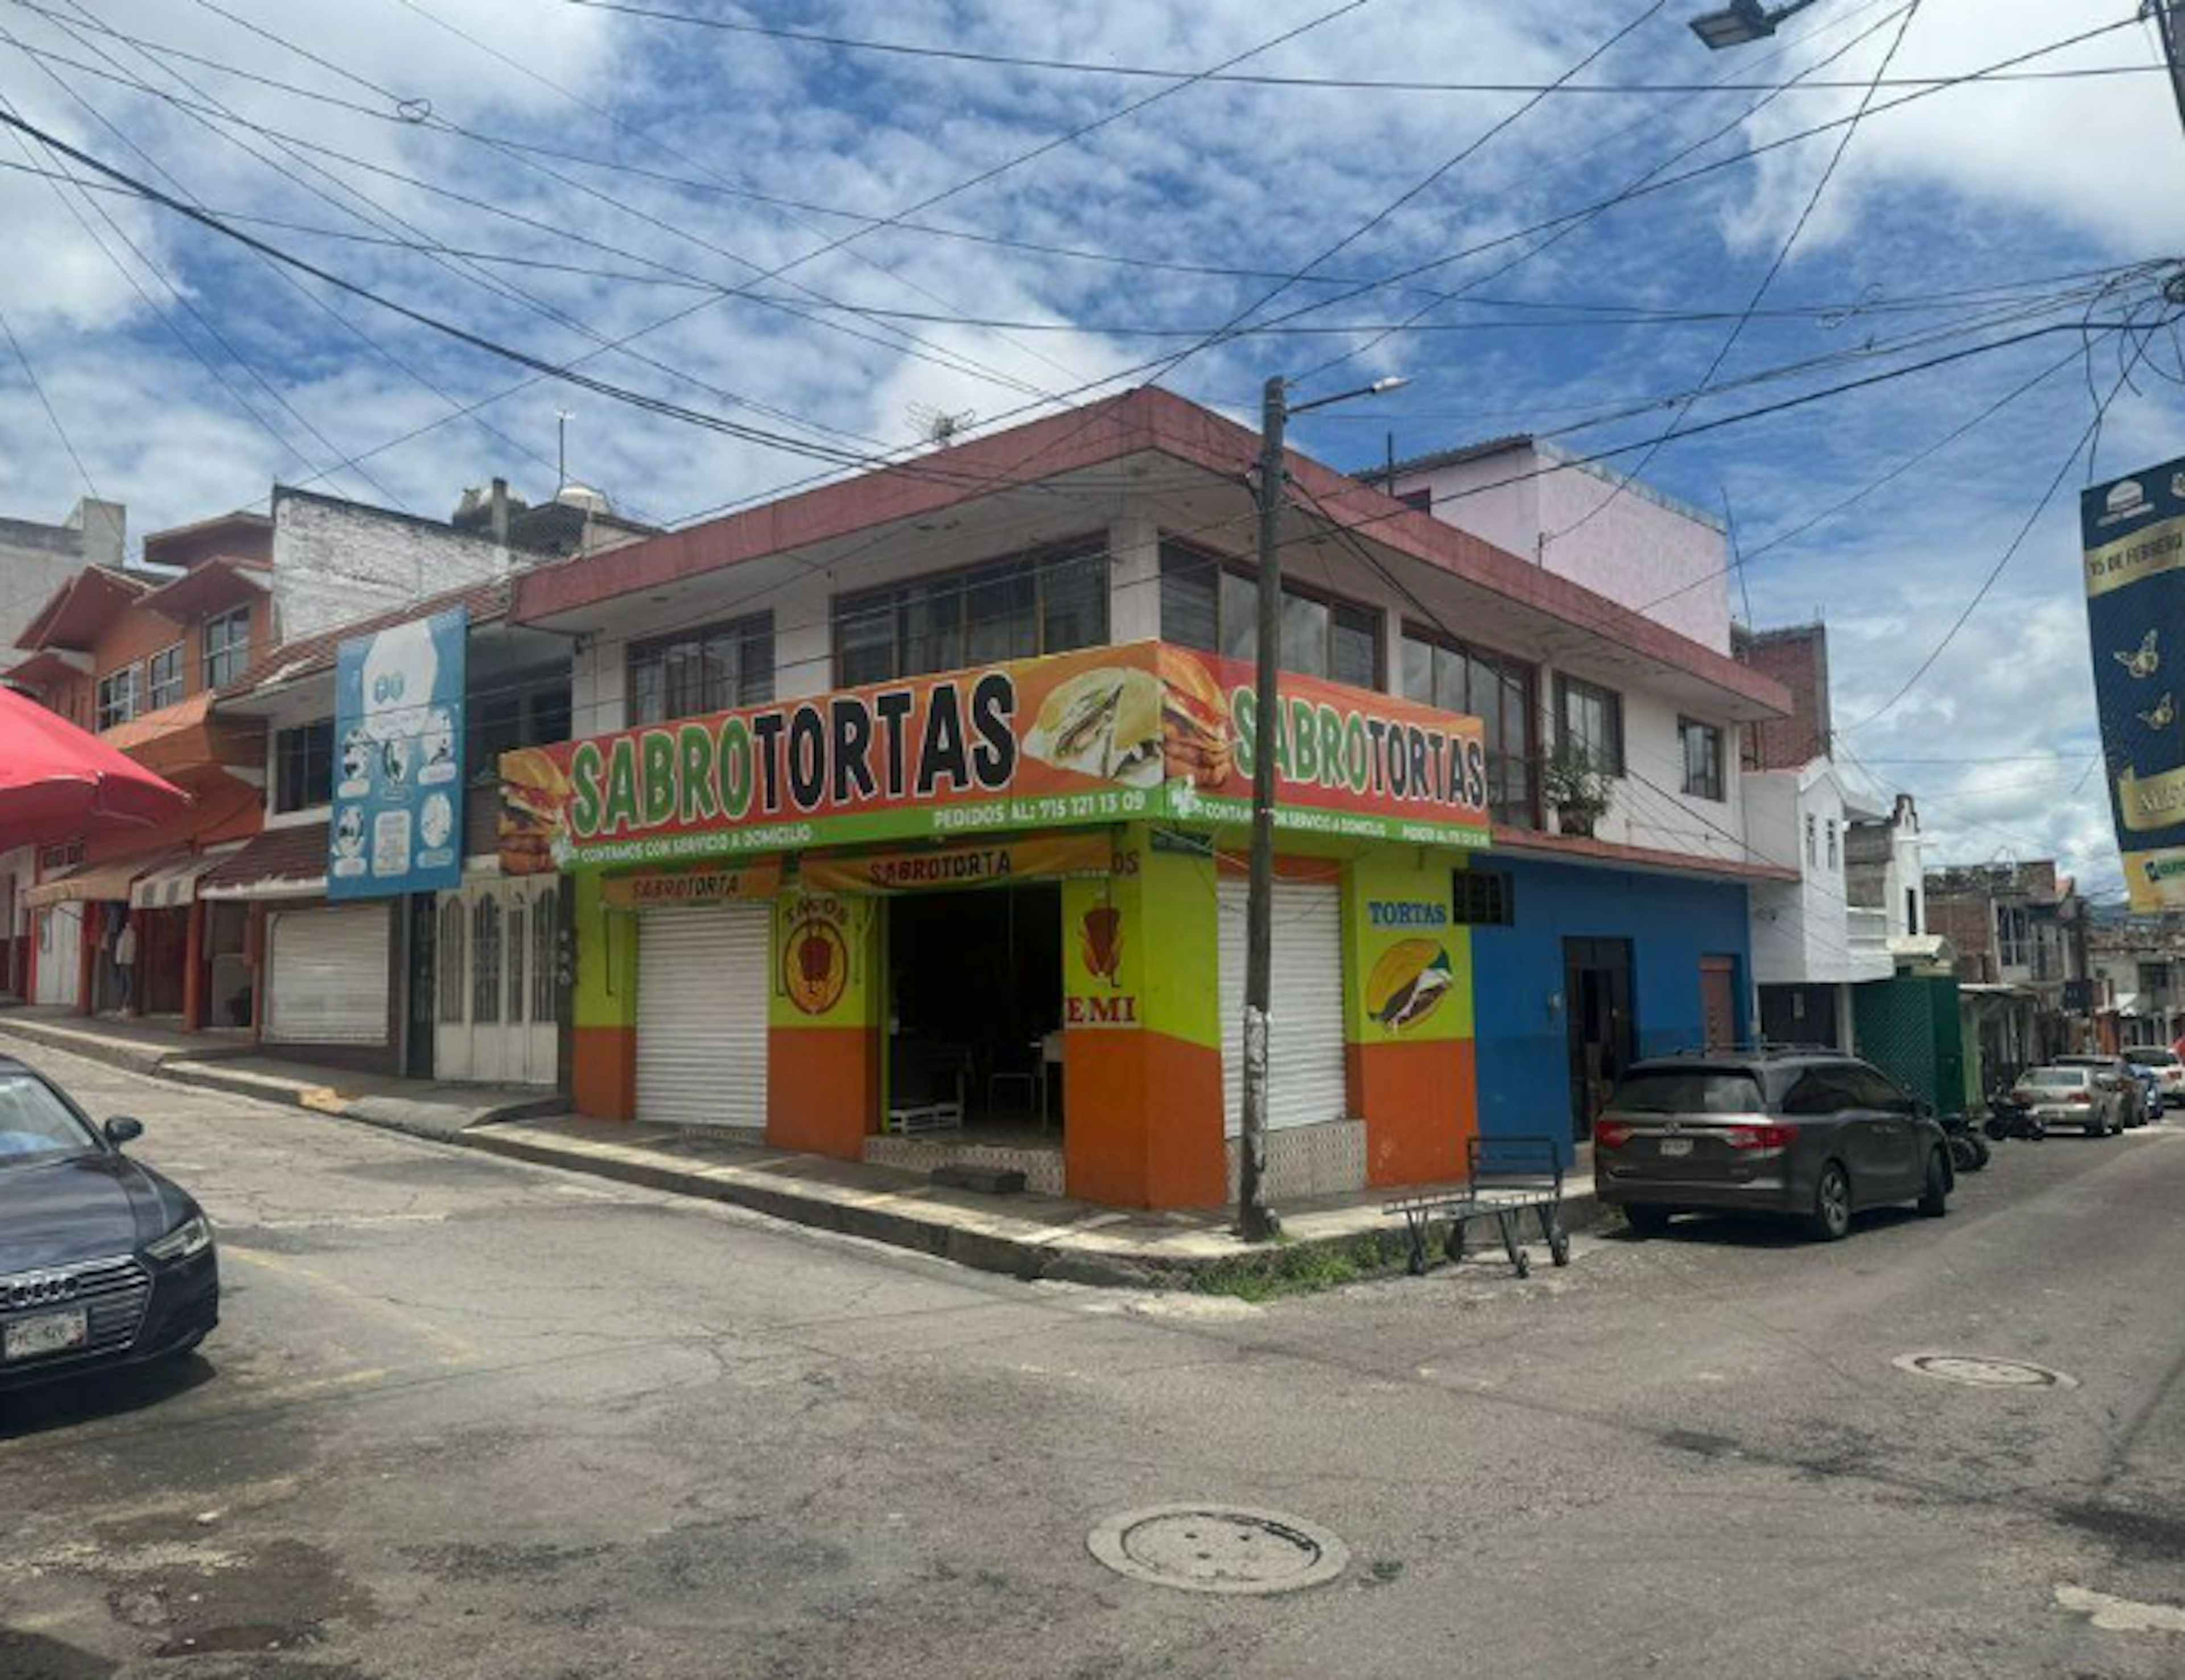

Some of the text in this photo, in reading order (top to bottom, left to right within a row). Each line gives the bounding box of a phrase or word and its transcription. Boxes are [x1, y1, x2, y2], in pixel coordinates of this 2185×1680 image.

[933, 805, 1005, 828] PEDIDOS
[870, 851, 1012, 885] SABROTORTA
[1368, 900, 1448, 925] TORTAS
[1067, 997, 1136, 1022] EMI
